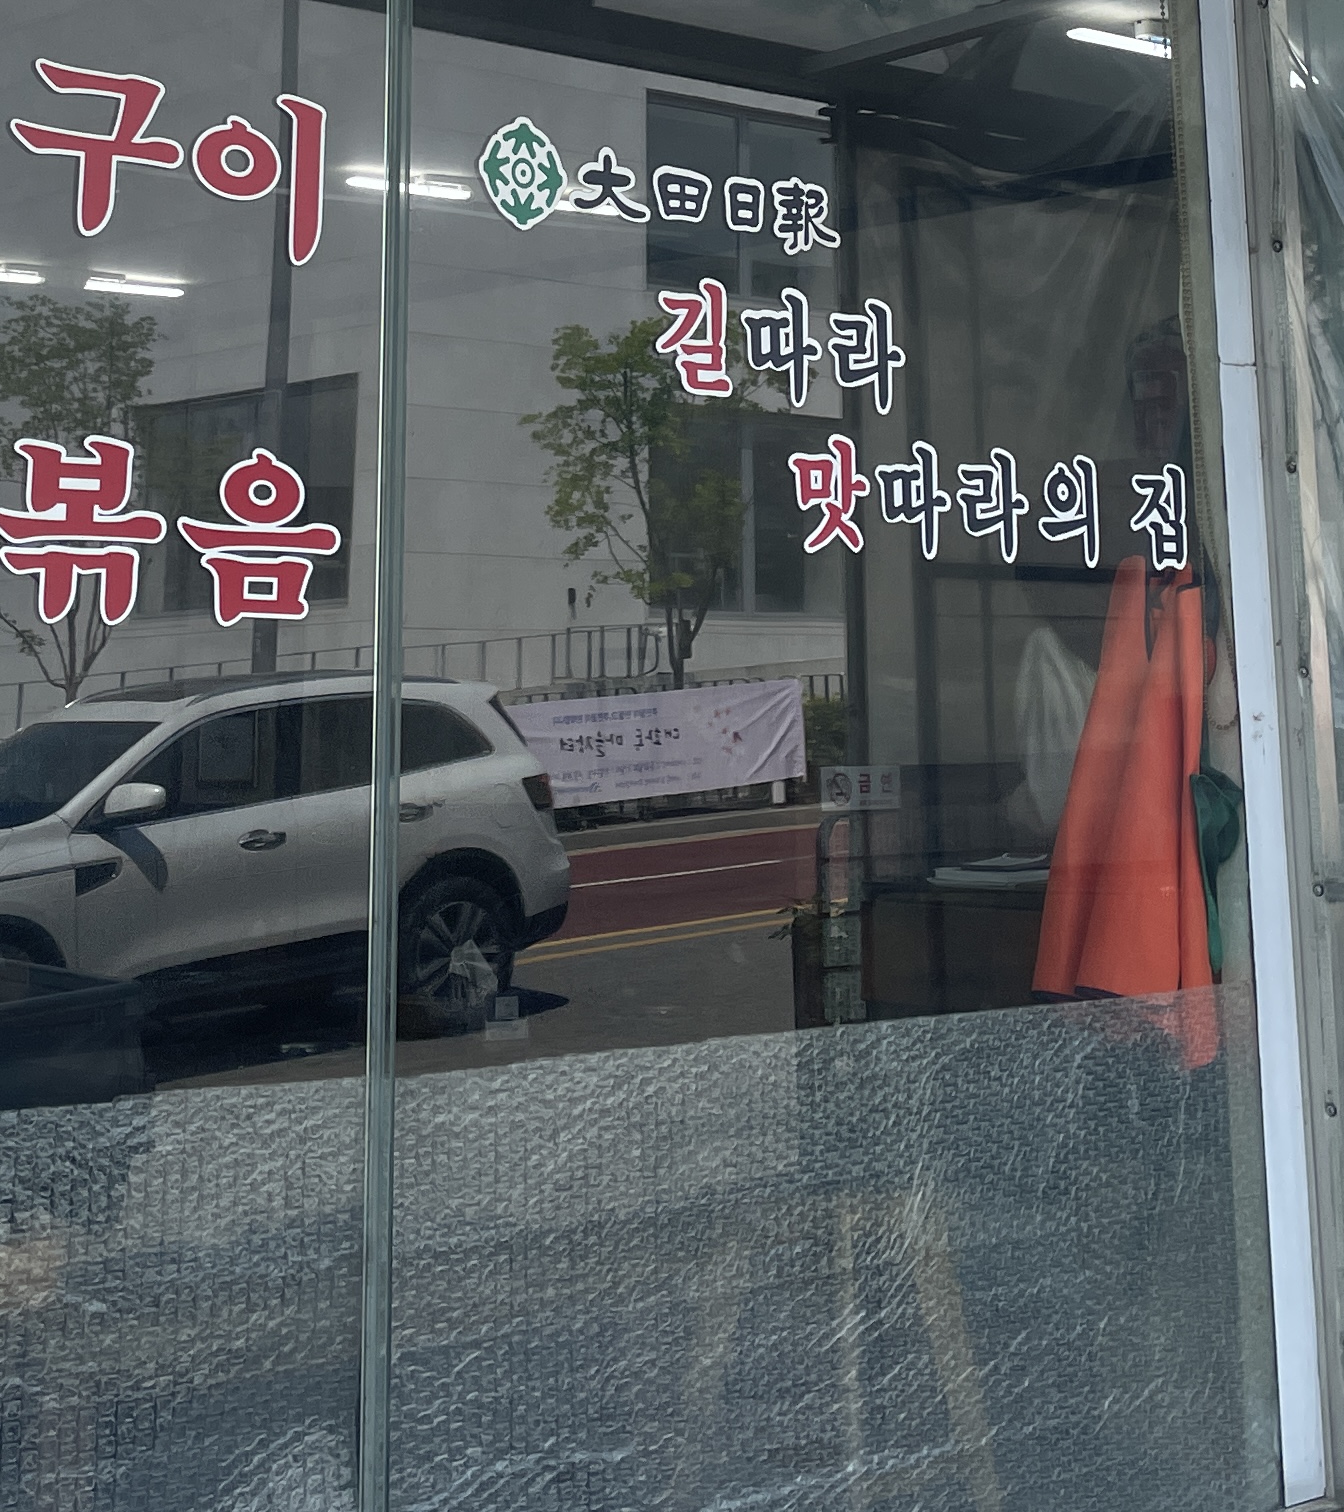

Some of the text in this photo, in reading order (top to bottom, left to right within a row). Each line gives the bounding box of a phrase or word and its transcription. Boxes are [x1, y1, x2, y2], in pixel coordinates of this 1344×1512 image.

[569, 147, 842, 256] 大田日報
[789, 434, 1192, 571] 맛따라의 집
